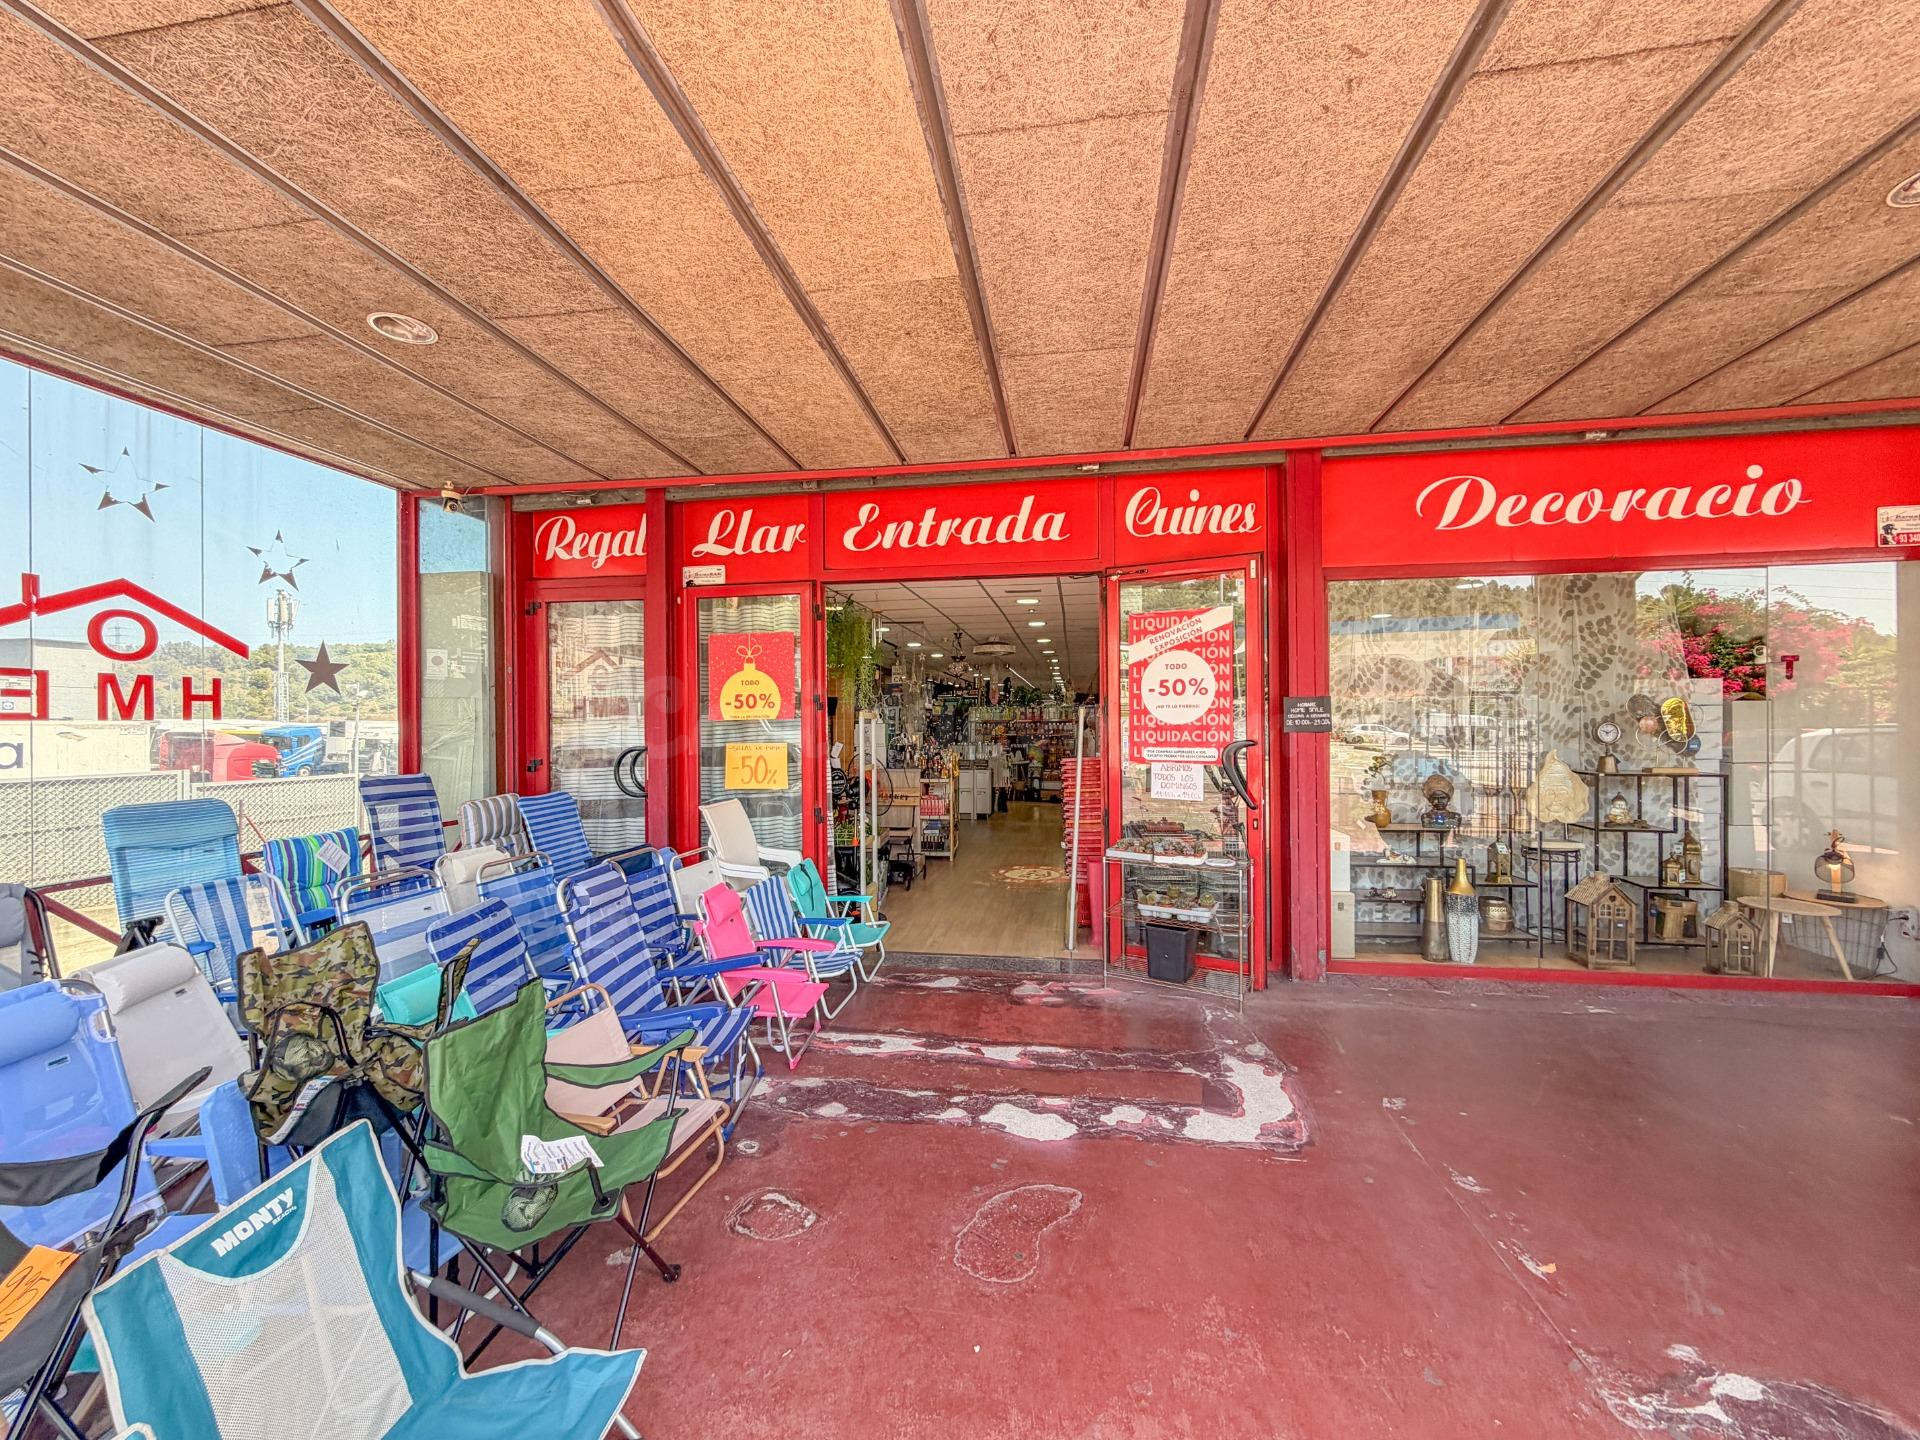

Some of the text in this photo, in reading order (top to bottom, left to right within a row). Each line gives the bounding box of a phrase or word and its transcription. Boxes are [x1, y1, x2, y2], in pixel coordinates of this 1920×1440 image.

[1125, 486, 1262, 538] Cuines
[1416, 464, 1812, 530] Decoracio
[691, 509, 807, 558] Llar
[843, 495, 1071, 552] Entrada
[725, 693, 775, 710] -50%
[1148, 677, 1208, 697] -50%
[1133, 727, 1231, 744] LIQUIDACIÓN
[731, 754, 778, 785] -50%
[1153, 772, 1194, 782] TODOS LOS
[1160, 781, 1198, 790] DOMINGOS
[210, 1186, 294, 1258] MONTY
